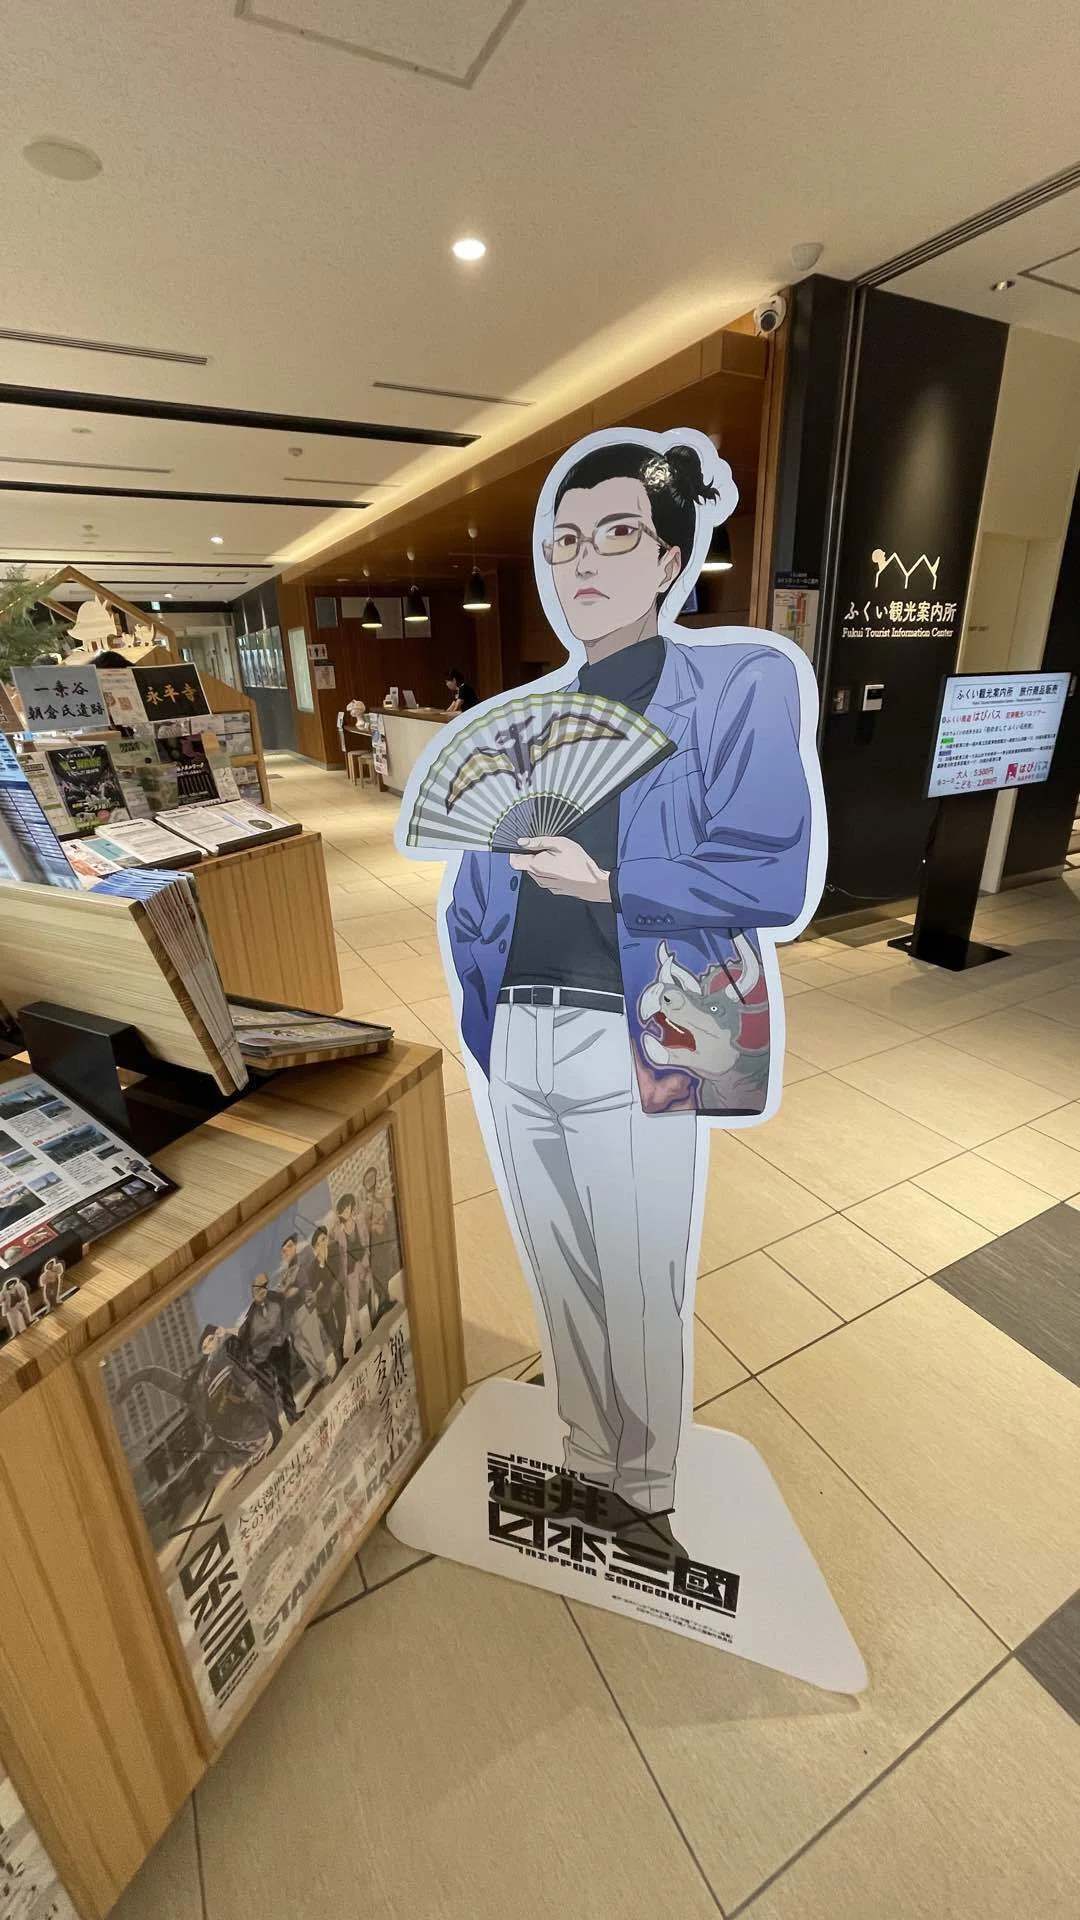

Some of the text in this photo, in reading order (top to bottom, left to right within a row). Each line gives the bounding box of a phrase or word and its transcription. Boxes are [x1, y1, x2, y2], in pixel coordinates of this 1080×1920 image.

[844, 601, 957, 622] ふくい観光案内所
[842, 627, 864, 638] Fukui
[865, 626, 890, 638] Tourist
[891, 626, 930, 638] Information
[931, 626, 954, 638] Center
[146, 683, 197, 705] 永平寺
[957, 687, 1014, 700] ふくい観光案内所
[28, 702, 105, 721] 朝倉氏遺跡
[263, 1530, 340, 1647] STAMP
[525, 1547, 695, 1609] NIPPON SANGOKU
